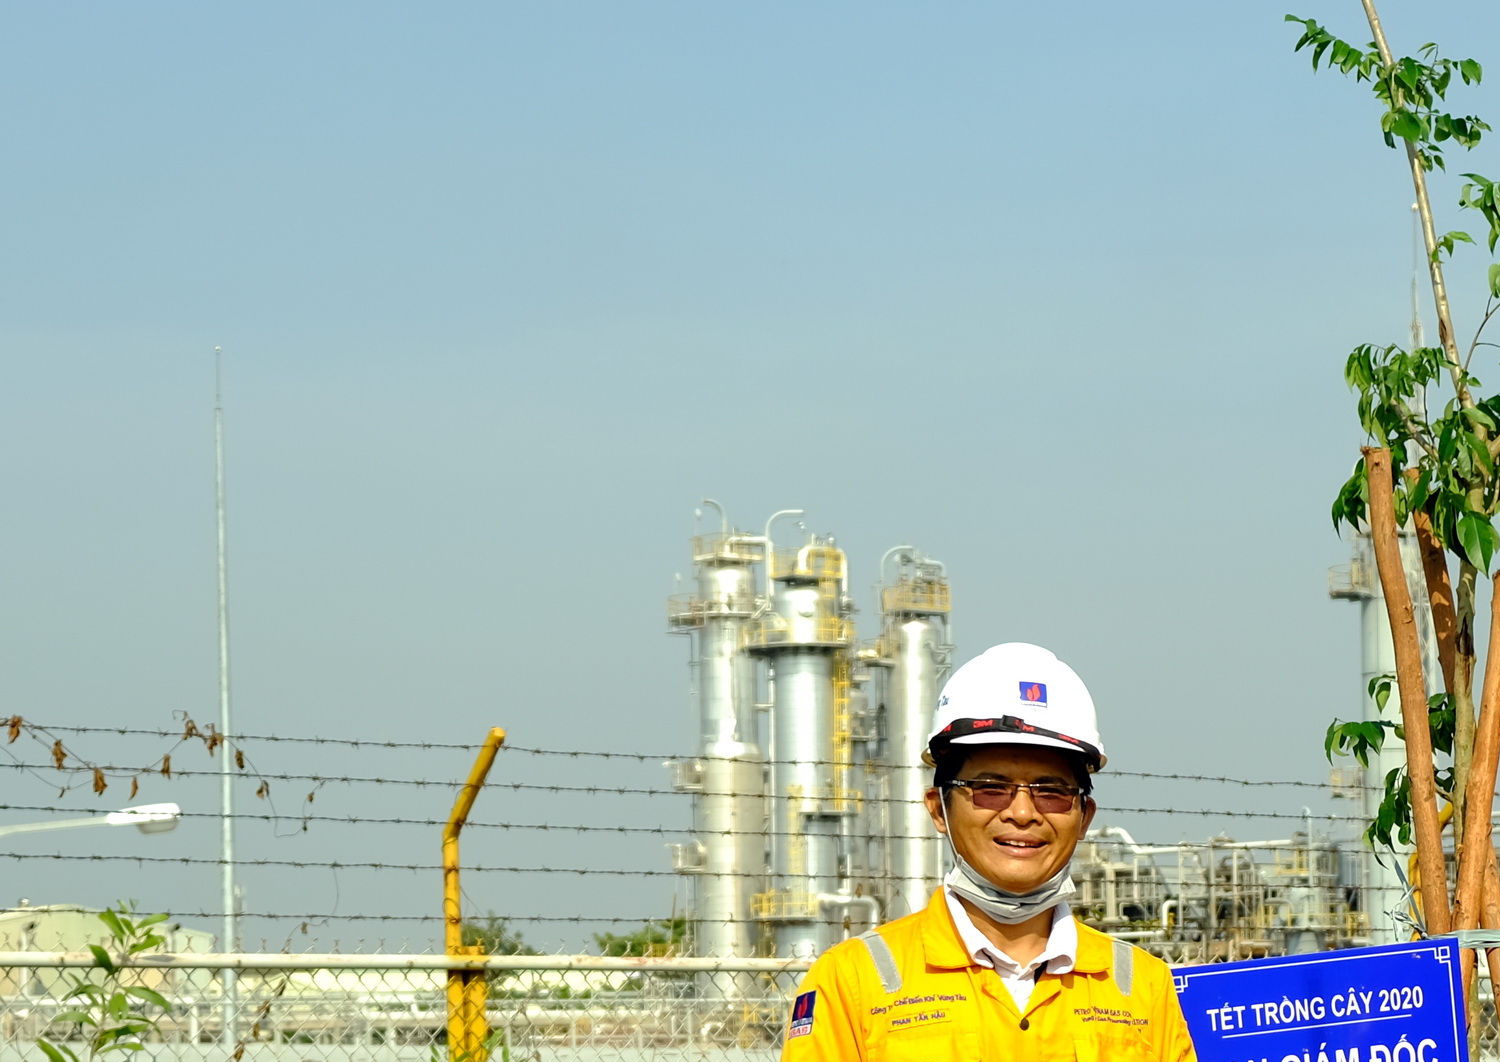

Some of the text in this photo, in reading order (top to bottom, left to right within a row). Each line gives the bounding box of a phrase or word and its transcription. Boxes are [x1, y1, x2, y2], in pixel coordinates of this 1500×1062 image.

[972, 719, 994, 729] 3M
[1206, 985, 1424, 1032] TẾT TRỒNG CÂY 2020
[892, 1017, 912, 1026] PHAN
